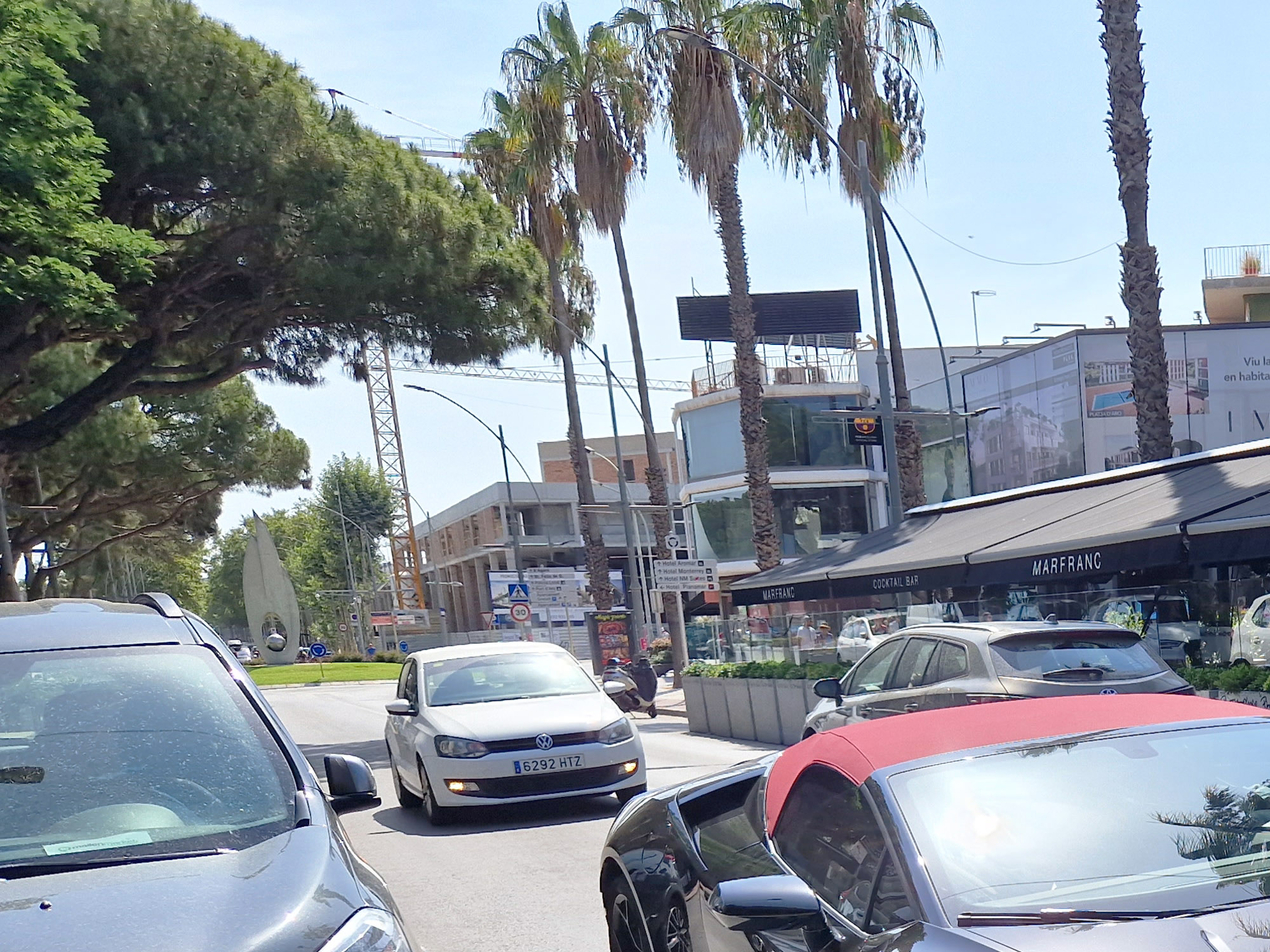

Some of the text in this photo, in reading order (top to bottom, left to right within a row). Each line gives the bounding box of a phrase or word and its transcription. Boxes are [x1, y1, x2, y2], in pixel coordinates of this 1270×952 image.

[1244, 357, 1261, 367] Viu
[1224, 374, 1236, 382] en
[1032, 551, 1102, 576] MARFRANC
[872, 575, 919, 590] COCKTAIL BAR
[762, 586, 795, 601] MARFRANC
[523, 755, 582, 772] 6292 HTZ
